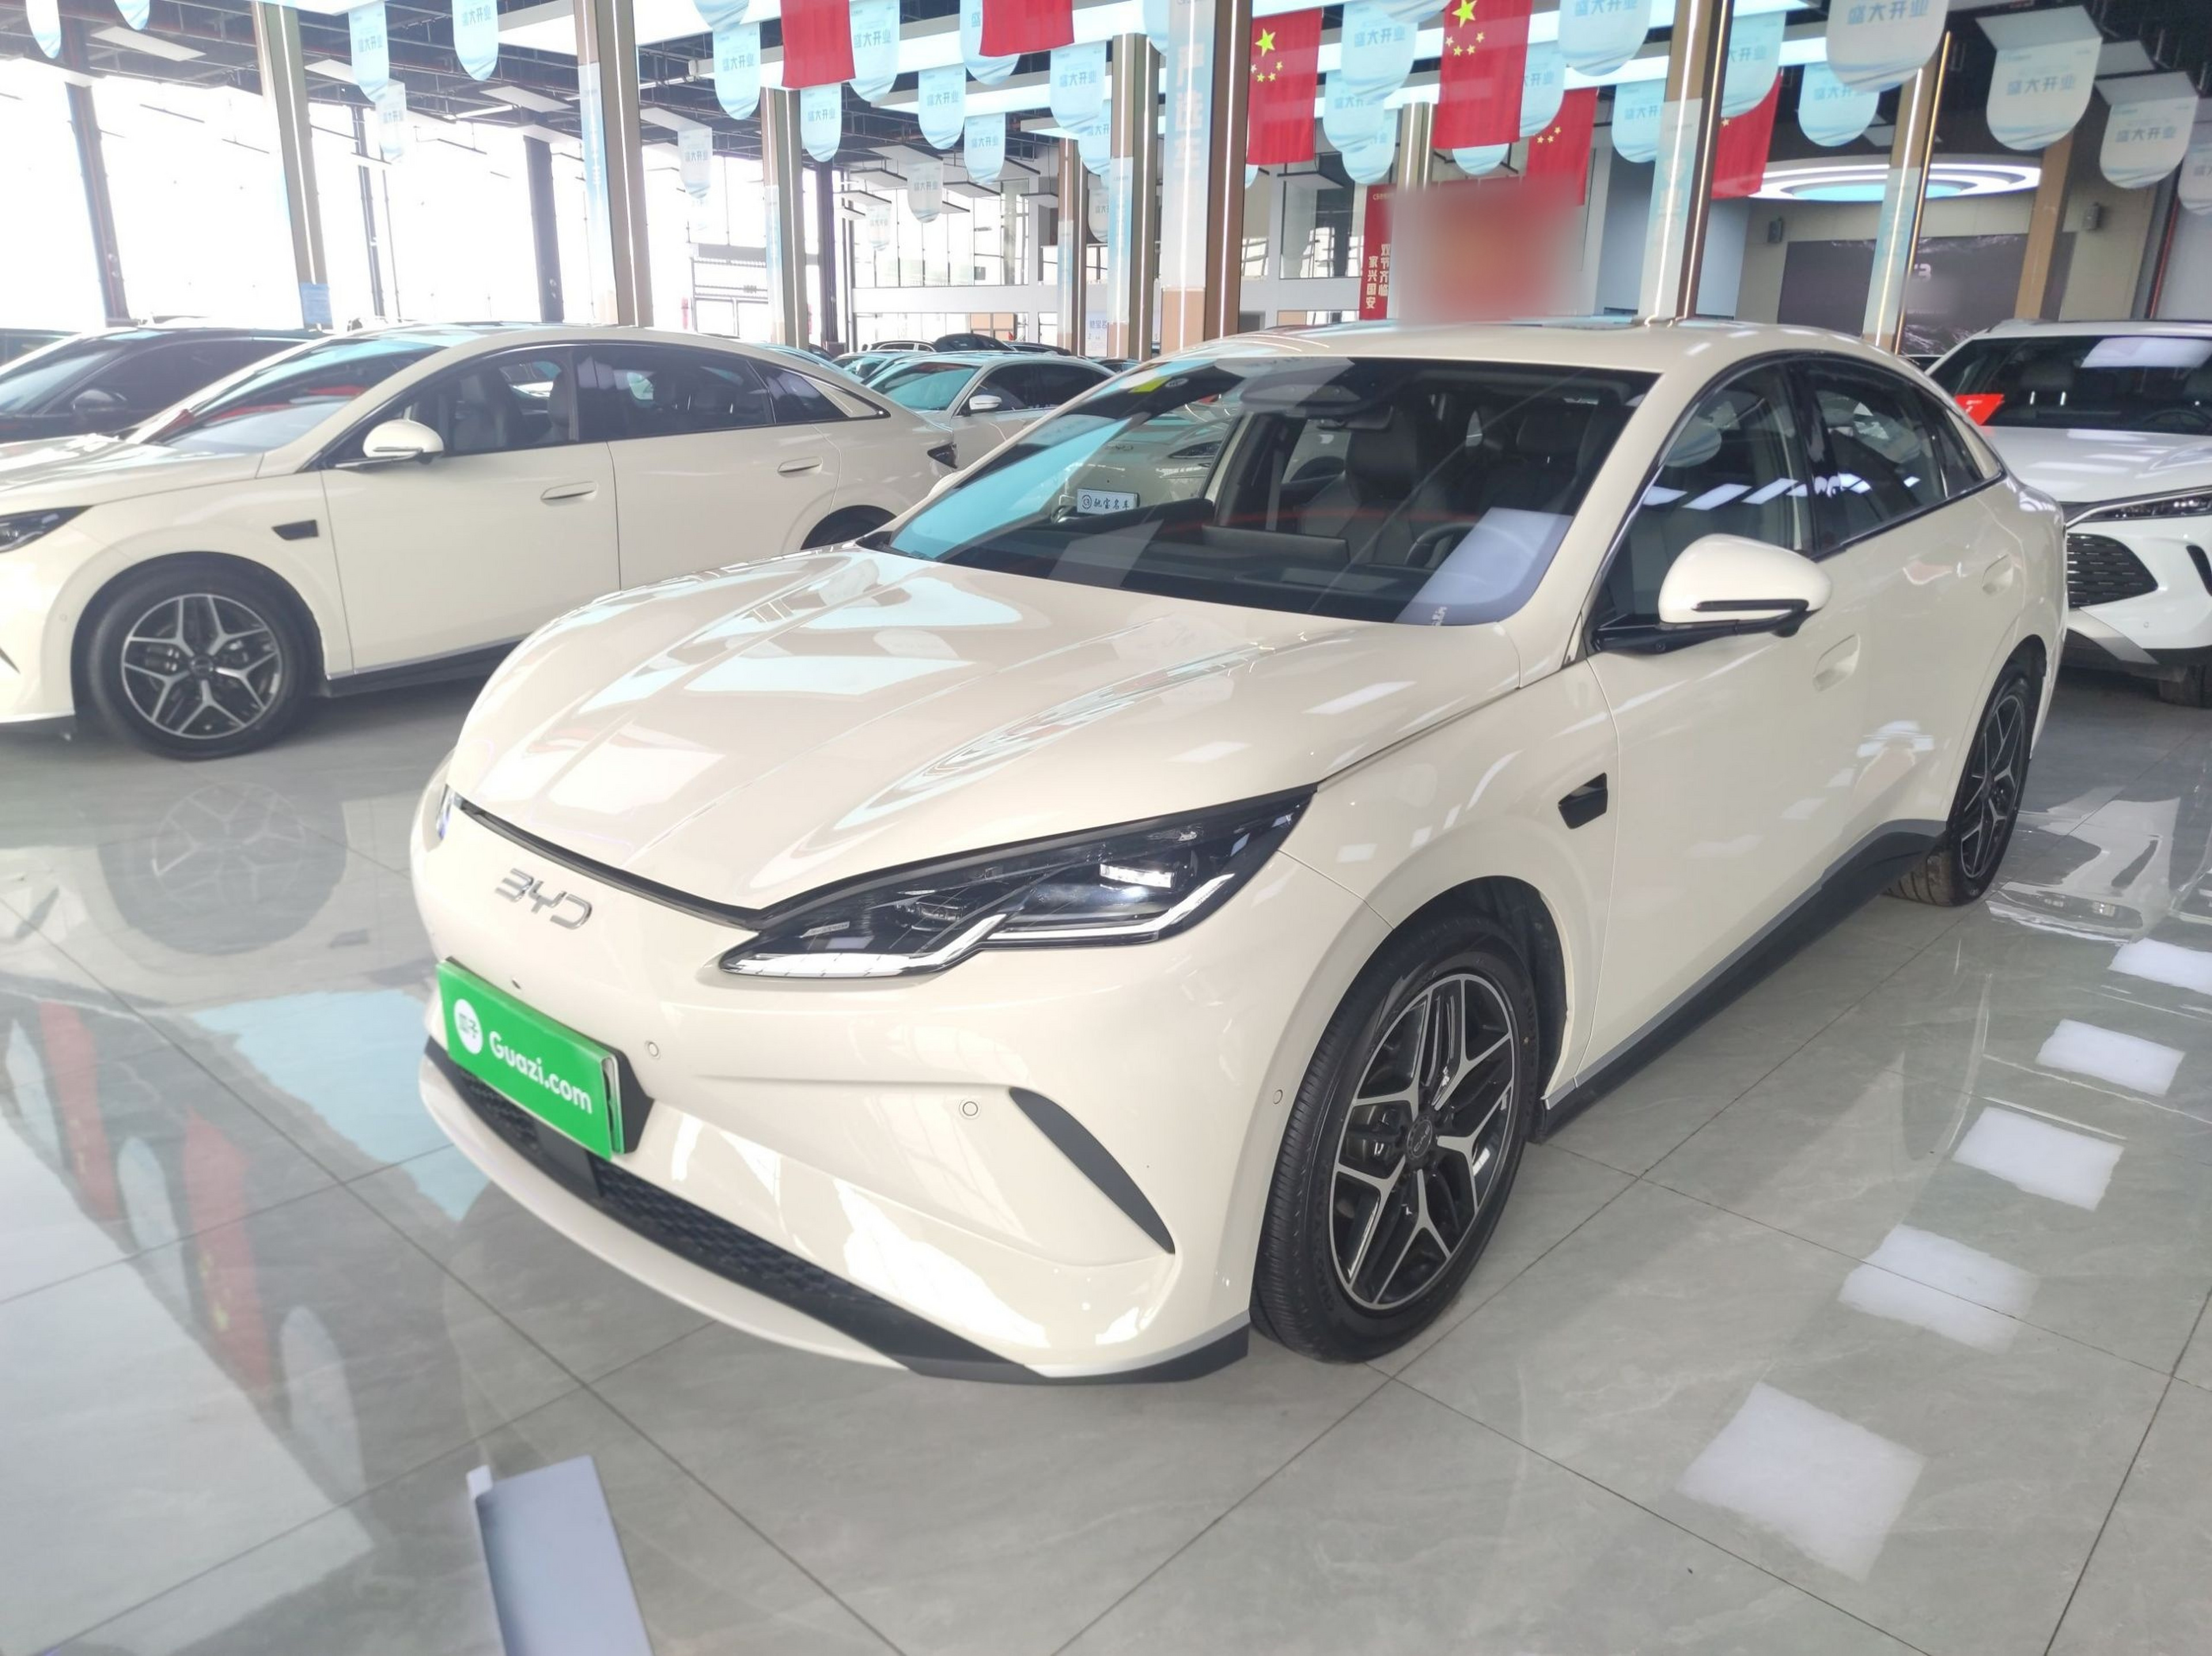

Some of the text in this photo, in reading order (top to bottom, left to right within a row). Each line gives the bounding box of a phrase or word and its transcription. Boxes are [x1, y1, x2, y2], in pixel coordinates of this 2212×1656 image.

[854, 29, 892, 48] 盛大开业
[1354, 27, 1406, 47] 盛大开业
[2006, 75, 2076, 96] 盛大开业
[2115, 126, 2177, 143] 盛大开业
[1366, 256, 1378, 309] 家兴国安
[1378, 244, 1391, 297] 双节齐临
[495, 867, 592, 930] BYD
[489, 1030, 593, 1114] Guazi.com
